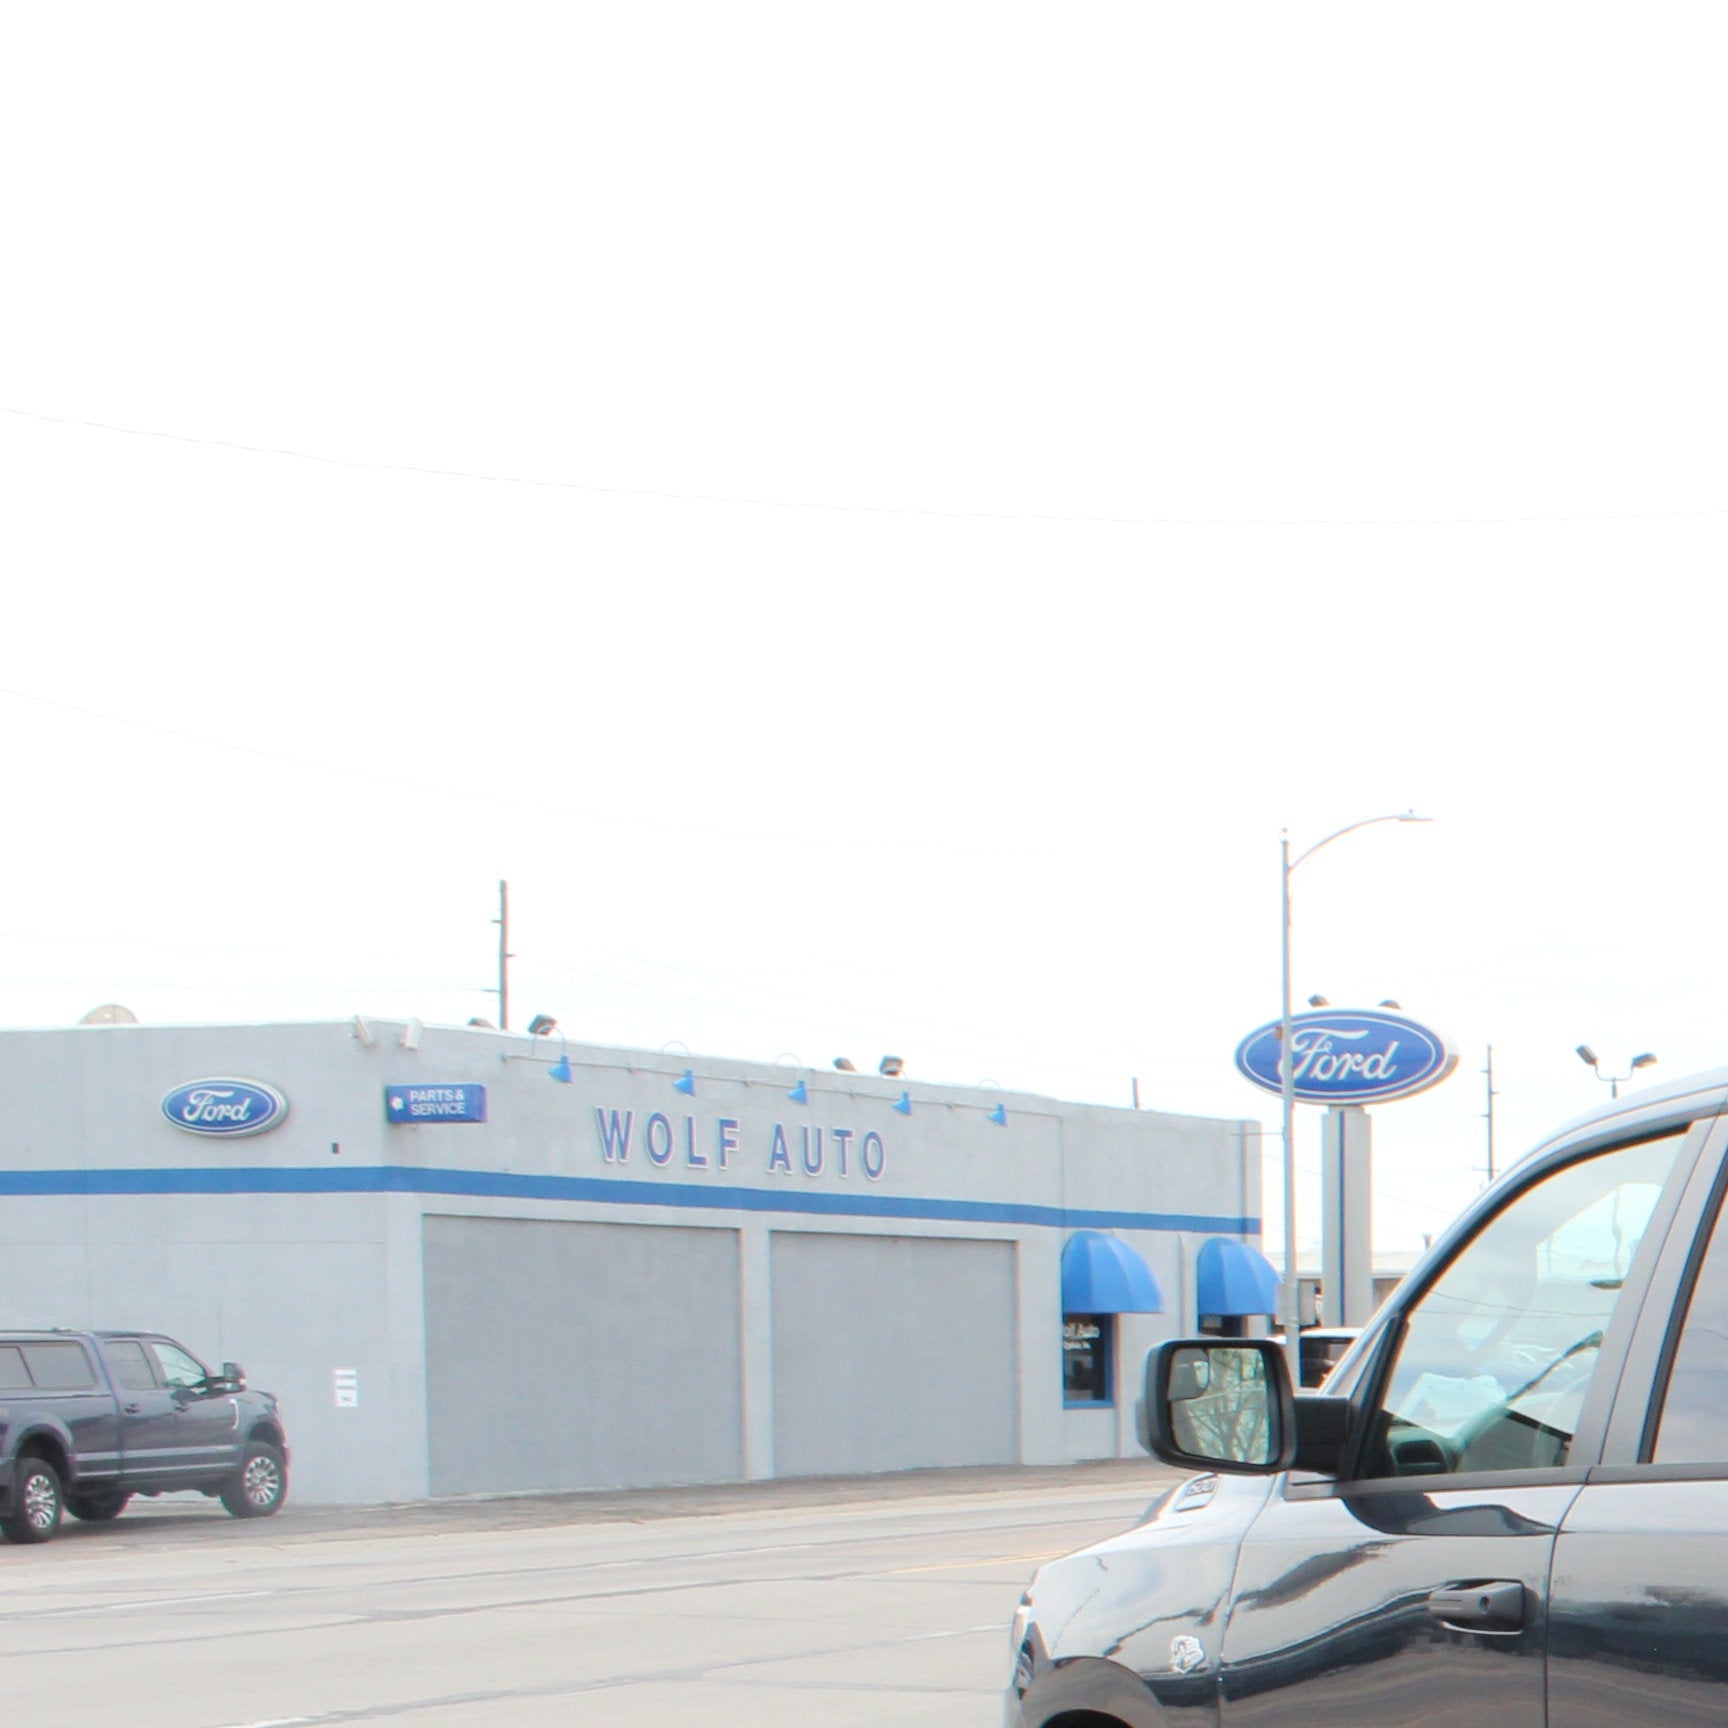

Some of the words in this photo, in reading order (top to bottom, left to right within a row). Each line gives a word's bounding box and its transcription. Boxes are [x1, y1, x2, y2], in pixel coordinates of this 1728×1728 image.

[1277, 1027, 1400, 1082] Ford
[183, 1089, 252, 1121] Ford
[408, 1089, 454, 1102] PARTS
[454, 1088, 465, 1101] &
[409, 1102, 466, 1116] SERVICE
[596, 1106, 740, 1170] WOLF
[766, 1121, 887, 1182] AUTO
